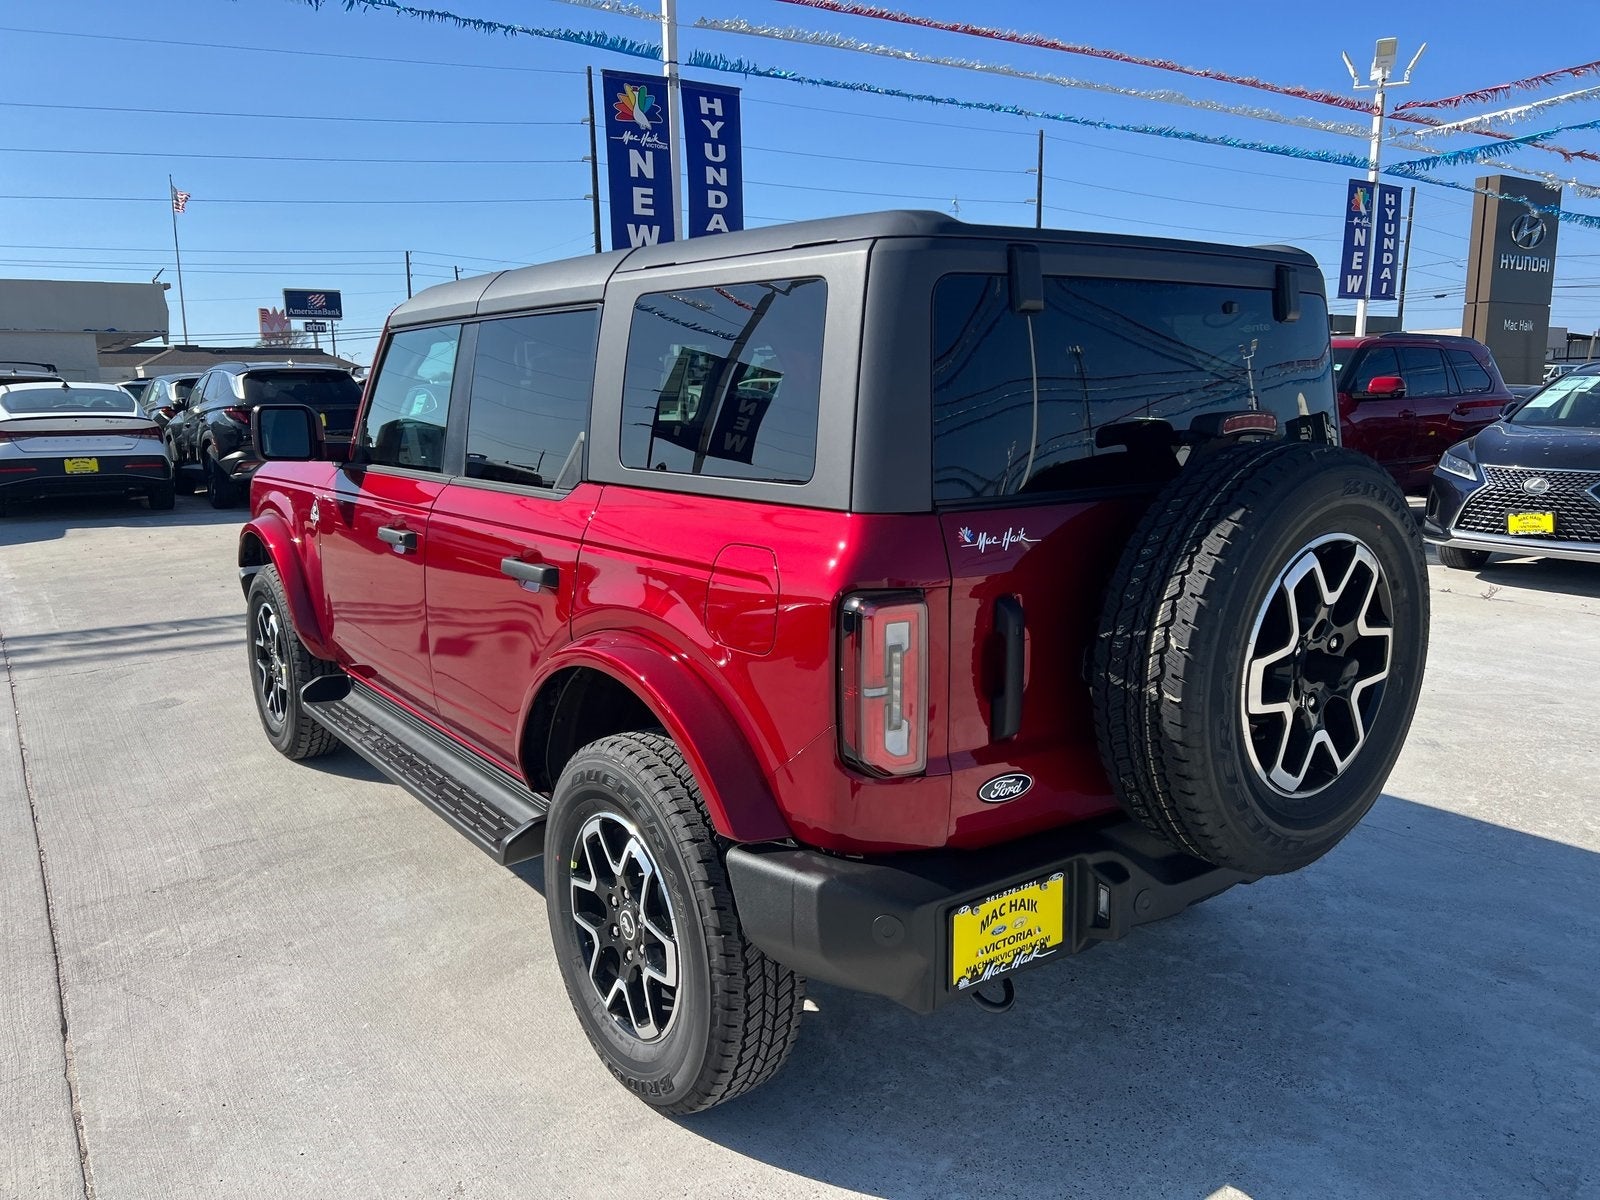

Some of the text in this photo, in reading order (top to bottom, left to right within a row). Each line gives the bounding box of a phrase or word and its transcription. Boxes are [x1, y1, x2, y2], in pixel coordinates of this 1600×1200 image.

[616, 130, 664, 147] Mac Haik
[627, 148, 660, 248] NEW
[1380, 193, 1396, 294] HYUNDAI
[1346, 228, 1366, 293] NEW
[1500, 253, 1550, 272] HYUNDAI
[306, 322, 326, 332] atm
[1504, 319, 1534, 331] Mac Haik
[969, 527, 1034, 553] Mac Haik
[989, 777, 1024, 799] Ford
[980, 903, 1006, 935] MAC
[1009, 898, 1038, 914] HAIK
[984, 928, 1033, 955] VICTORIA
[974, 946, 1047, 983] Mac Haik
